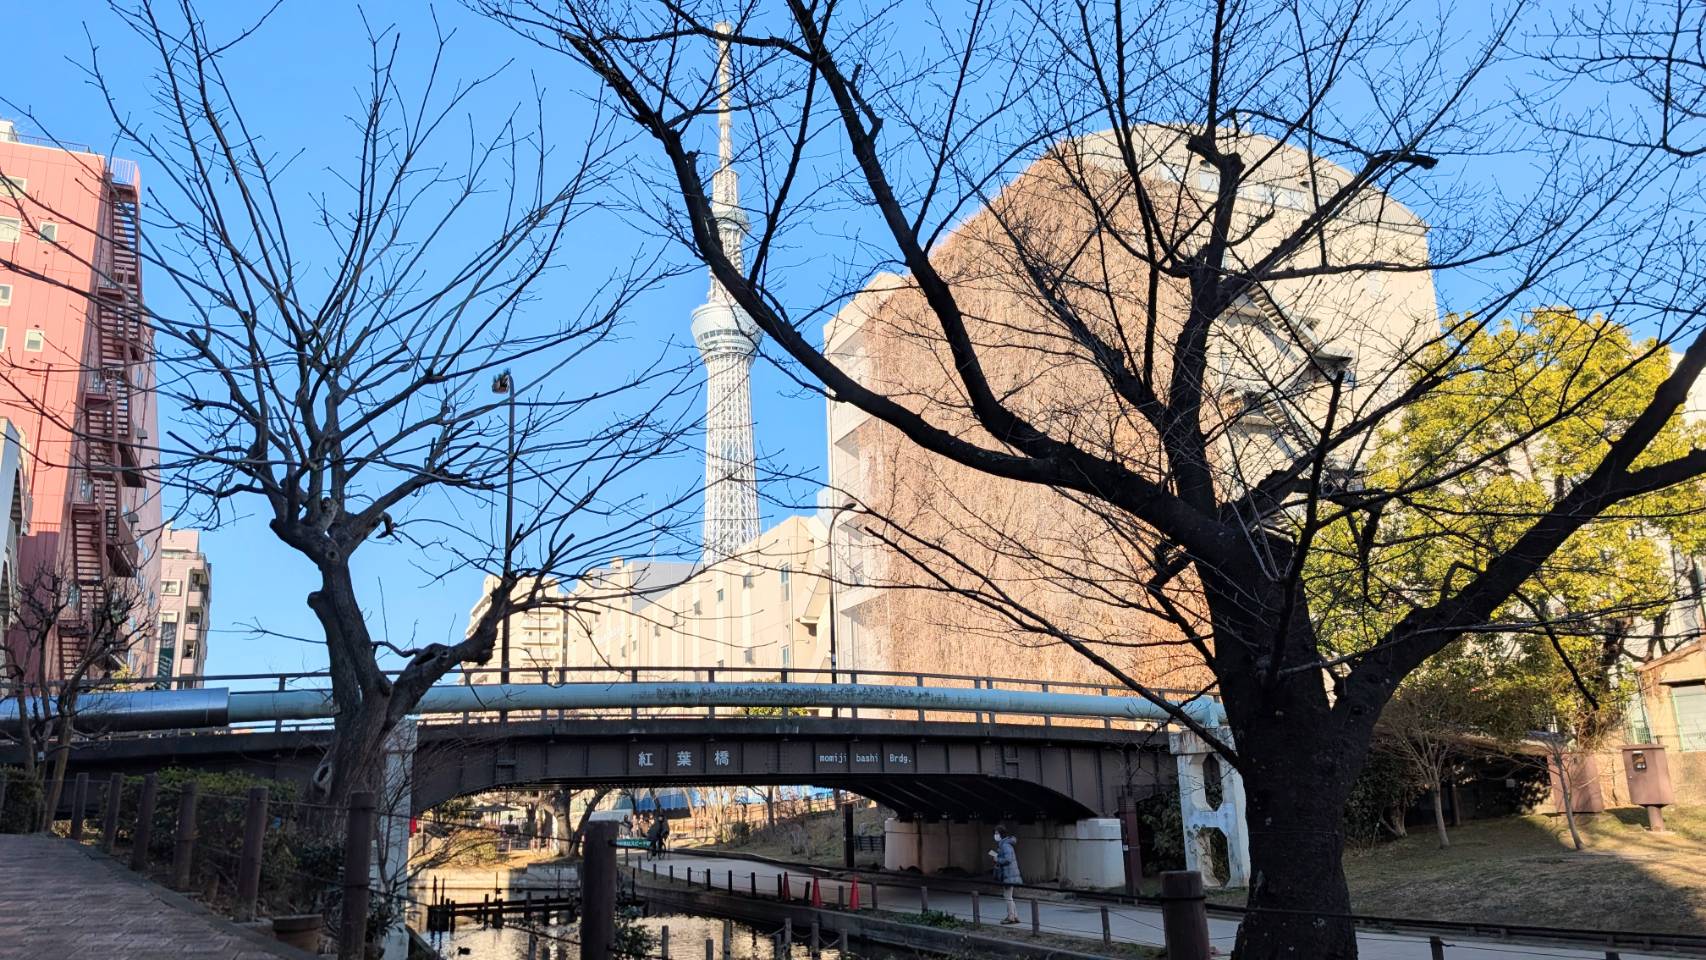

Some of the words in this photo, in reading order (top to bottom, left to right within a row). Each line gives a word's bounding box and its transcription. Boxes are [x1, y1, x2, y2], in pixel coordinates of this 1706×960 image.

[638, 750, 730, 767] 紅葉橋
[819, 753, 847, 763] momiji
[855, 753, 879, 763] bashi
[889, 753, 912, 764] Brdg.
